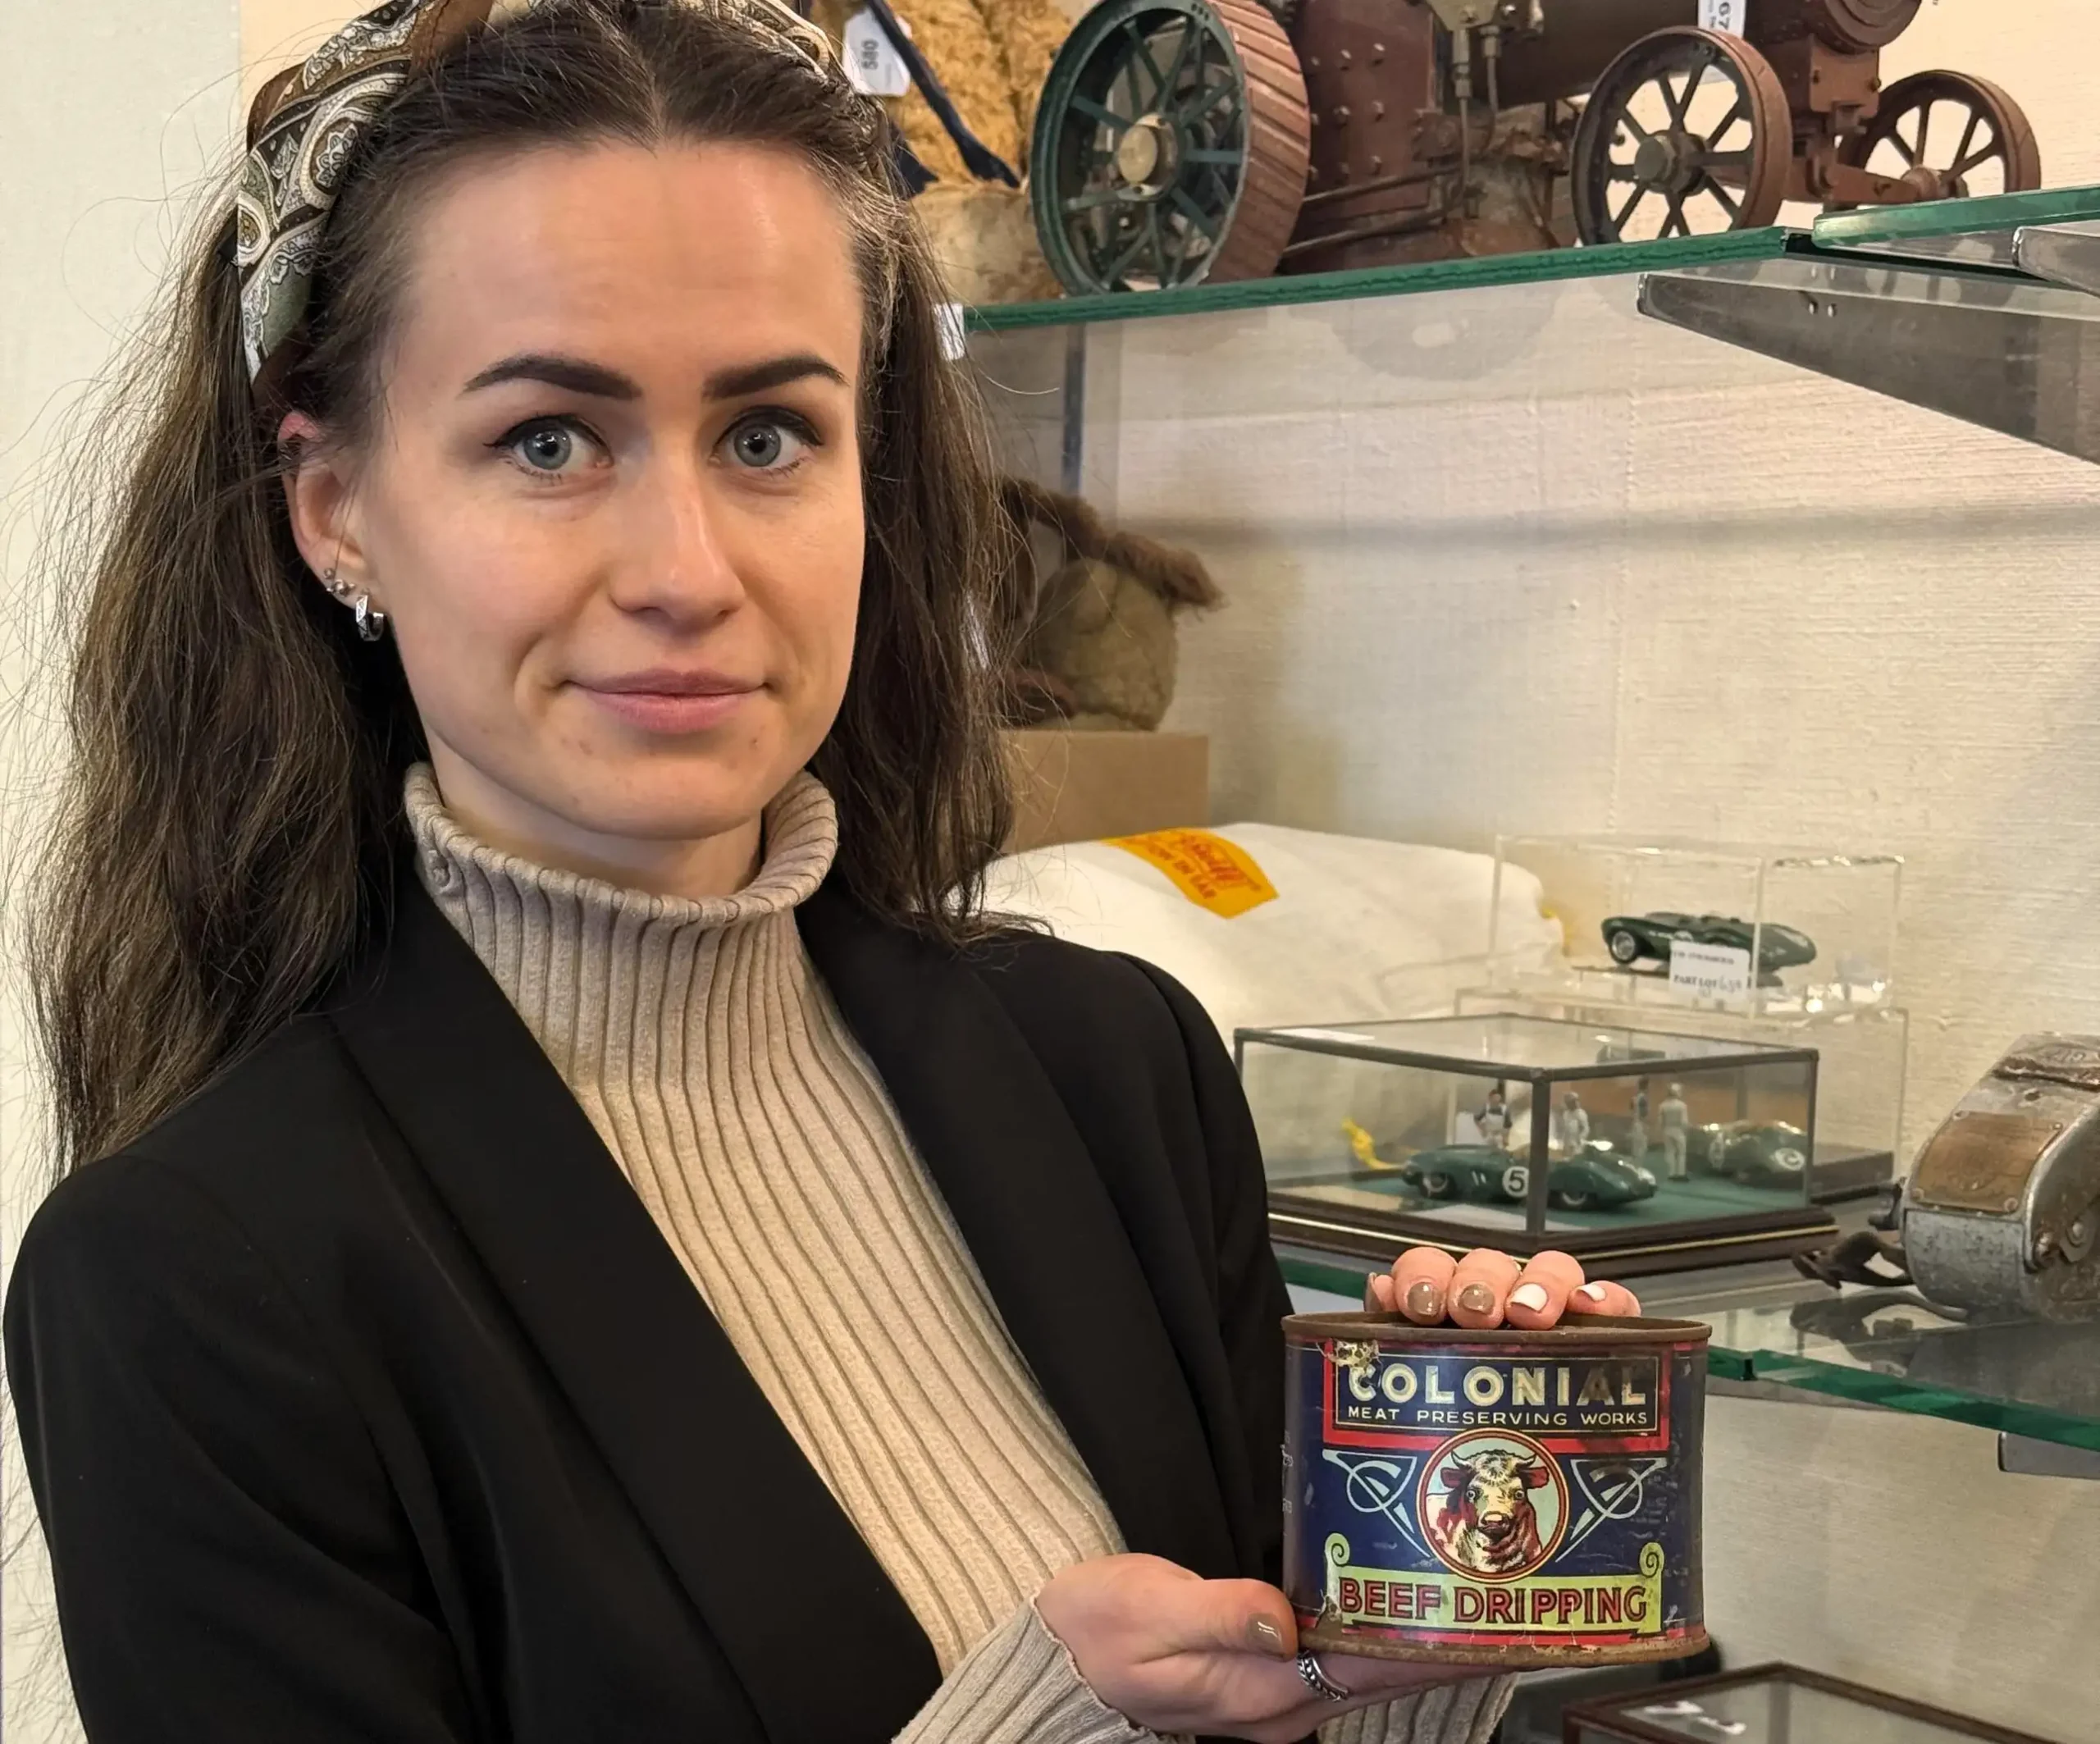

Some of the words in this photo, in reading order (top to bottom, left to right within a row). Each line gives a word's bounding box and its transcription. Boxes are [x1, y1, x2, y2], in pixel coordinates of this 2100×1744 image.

[1509, 1169, 1526, 1193] 5
[1349, 1363, 1646, 1406] COLONIAL
[1348, 1406, 1399, 1421] MEAT
[1417, 1409, 1568, 1426] PRESERVING
[1580, 1412, 1647, 1425] WORKS
[1339, 1577, 1441, 1620] BEEF
[1454, 1585, 1646, 1624] DRIPPING
